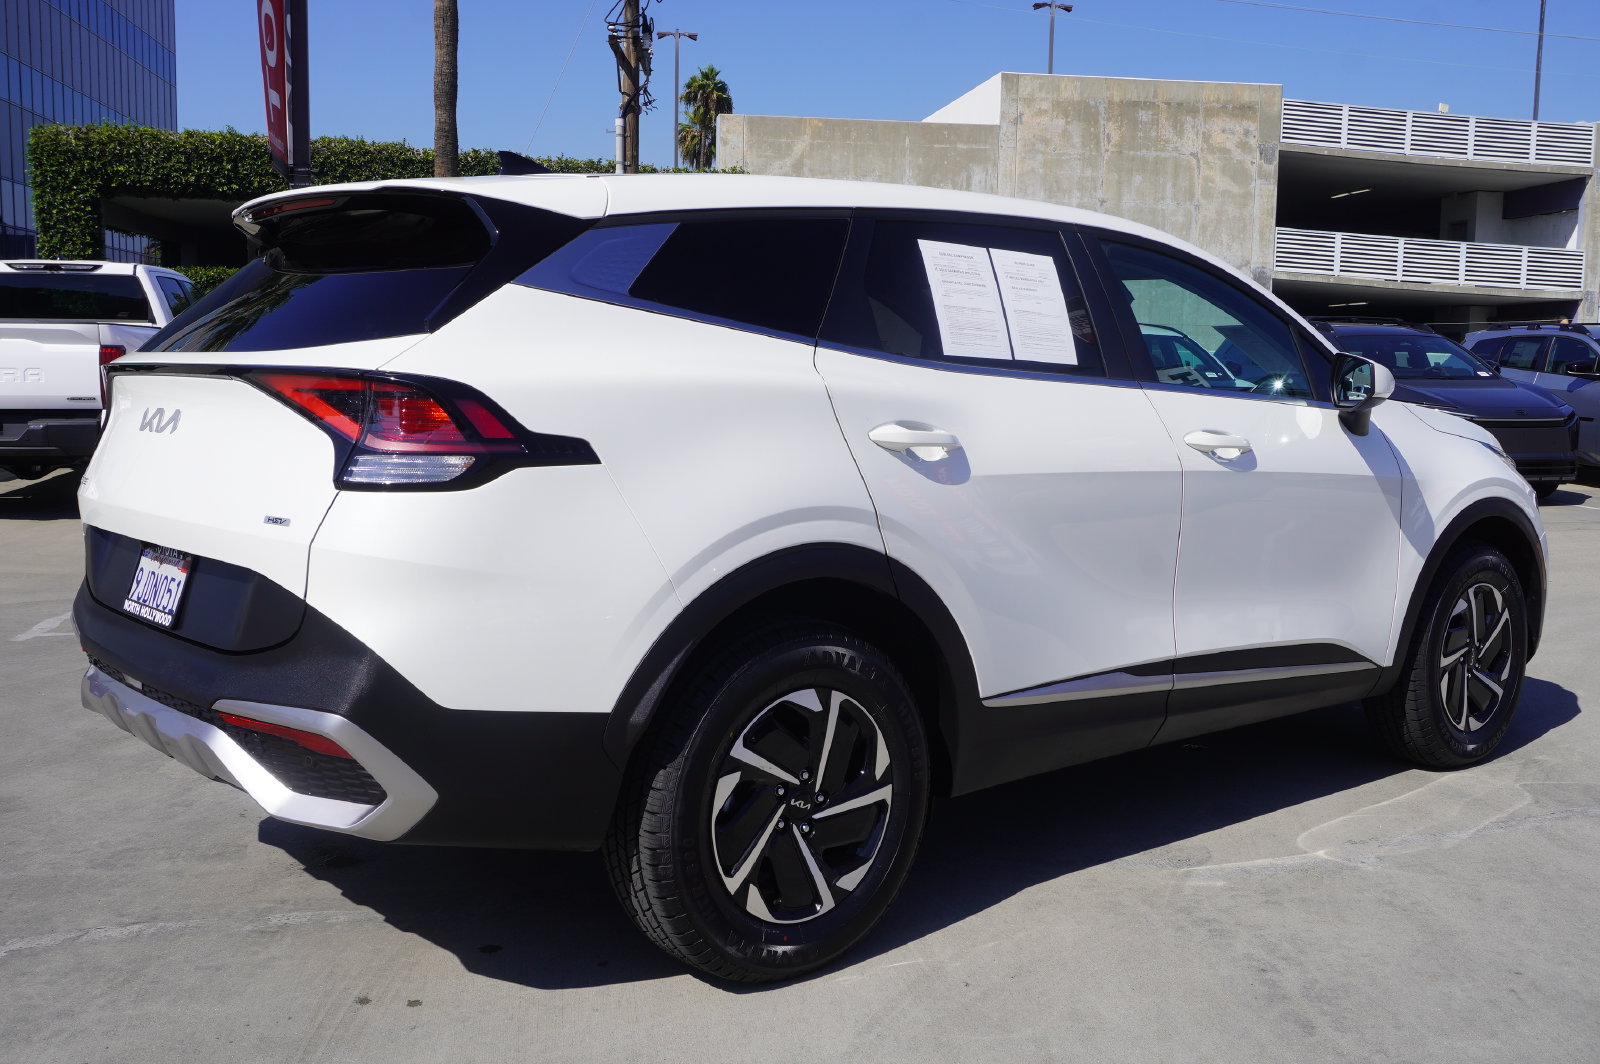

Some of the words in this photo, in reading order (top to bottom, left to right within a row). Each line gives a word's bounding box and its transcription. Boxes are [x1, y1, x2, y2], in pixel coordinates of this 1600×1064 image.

[139, 408, 181, 434] KIA
[128, 567, 182, 615] 9JDN051
[123, 599, 141, 615] NORTH
[140, 605, 172, 626] HOLLYWOOD
[790, 798, 811, 810] KIA
